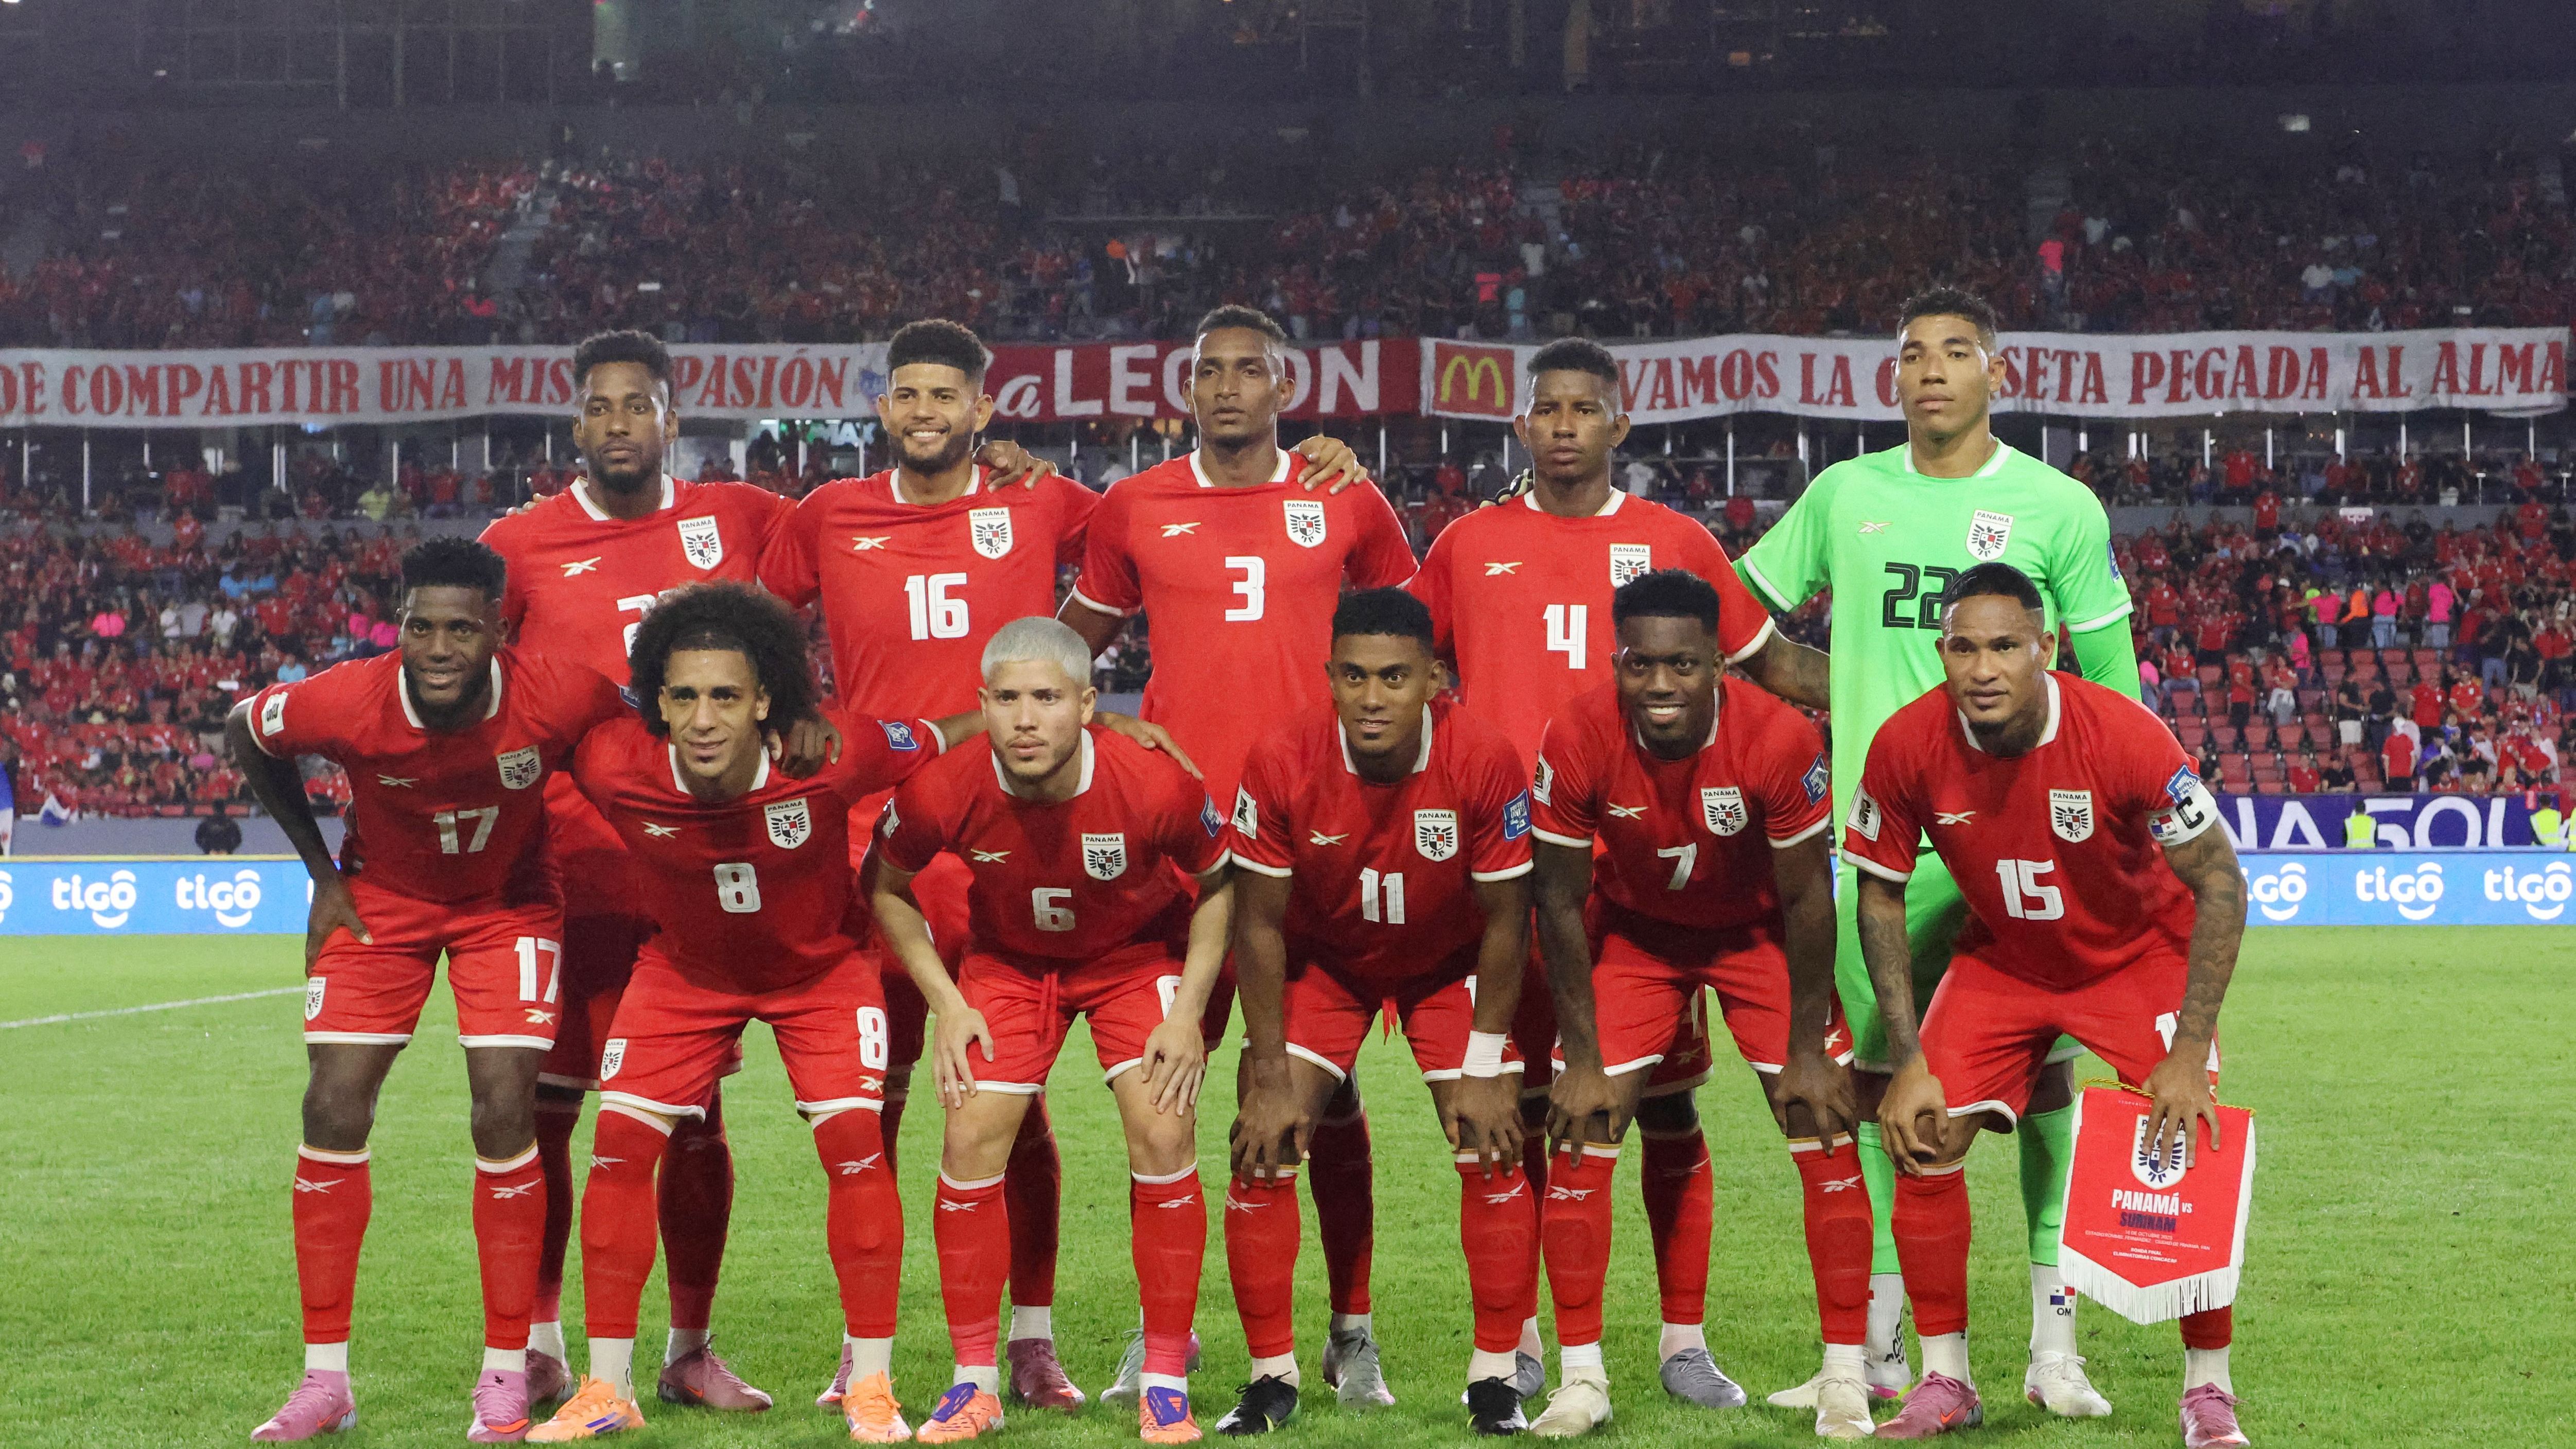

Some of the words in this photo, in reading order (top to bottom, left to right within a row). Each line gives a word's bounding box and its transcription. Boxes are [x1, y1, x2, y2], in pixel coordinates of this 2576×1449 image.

[0, 361, 47, 415] DE
[61, 359, 360, 416] COMPARTIR
[378, 358, 466, 412] UNA
[674, 348, 849, 409] PASIÓN
[1617, 348, 1780, 412] VAMOS
[1798, 353, 1857, 407] LA
[1875, 346, 2108, 407] CSETA
[2128, 345, 2329, 405] PEGADA
[2351, 345, 2412, 399] AL
[2431, 341, 2567, 396] ALMA
[904, 572, 969, 641] 16
[1225, 556, 1265, 622] 3
[1882, 562, 1959, 630] 22
[1543, 604, 1587, 670] 4
[433, 806, 499, 854] 17
[2175, 796, 2205, 829] C
[713, 862, 761, 913] 8
[1359, 867, 1405, 924] 11
[1657, 842, 1697, 891] 7
[1995, 859, 2064, 920] 15
[1032, 887, 1076, 932] 6
[515, 936, 562, 1005] 17
[856, 1006, 888, 1072] 8
[2111, 1189, 2180, 1216] PANAMÁ
[2182, 1201, 2194, 1214] VS
[2056, 1307, 2072, 1317] OM
